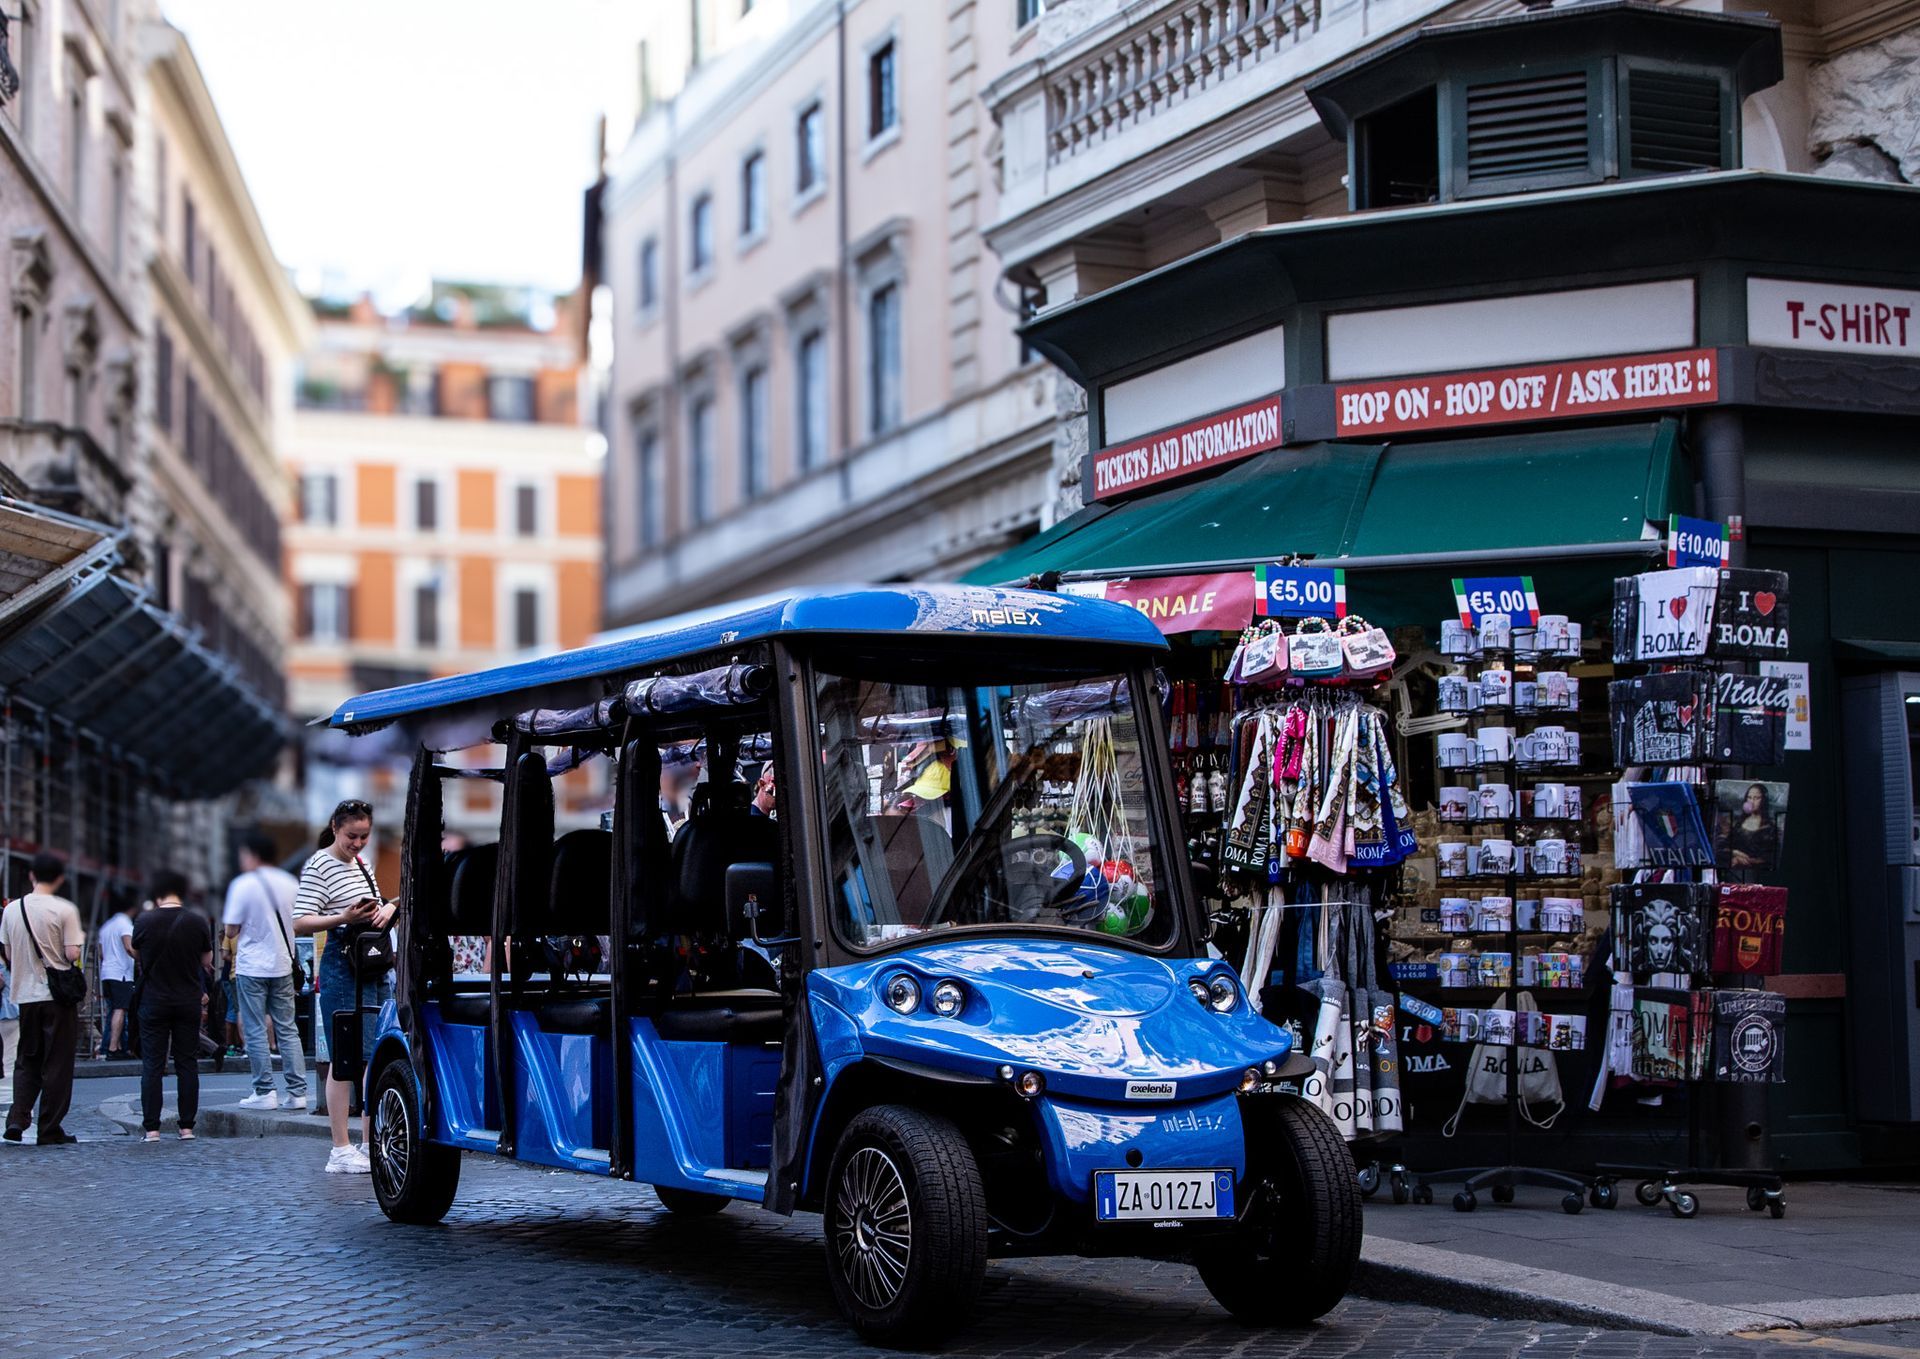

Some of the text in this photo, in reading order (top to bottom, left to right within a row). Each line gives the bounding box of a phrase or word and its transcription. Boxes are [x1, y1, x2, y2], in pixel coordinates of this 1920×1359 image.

[1341, 390, 1390, 426] HOP
[1394, 386, 1430, 421] ON
[1445, 380, 1495, 416] HOP
[1499, 374, 1547, 411] OFF
[1550, 373, 1562, 412] /
[1566, 367, 1620, 405] ASK
[1623, 359, 1693, 400] HERE
[1696, 357, 1711, 392] !!
[1095, 405, 1279, 492] TICKETS AND INFORMATION
[1677, 532, 1721, 560] €10,00
[1269, 579, 1332, 605] €5,00
[1739, 591, 1750, 612] I
[971, 605, 1042, 627] melex
[1657, 599, 1666, 620] I
[1641, 631, 1697, 654] ROMA
[1717, 623, 1789, 649] ROMA
[1718, 672, 1790, 708] Italia
[1224, 845, 1248, 864] OMA
[1649, 847, 1712, 866] ITALIA
[1716, 907, 1785, 935] ROMA
[1405, 998, 1438, 1020] €5,00
[1405, 1053, 1452, 1073] MA
[1130, 1083, 1173, 1095] exelentia
[1117, 1181, 1216, 1211] ZA 012ZJ
